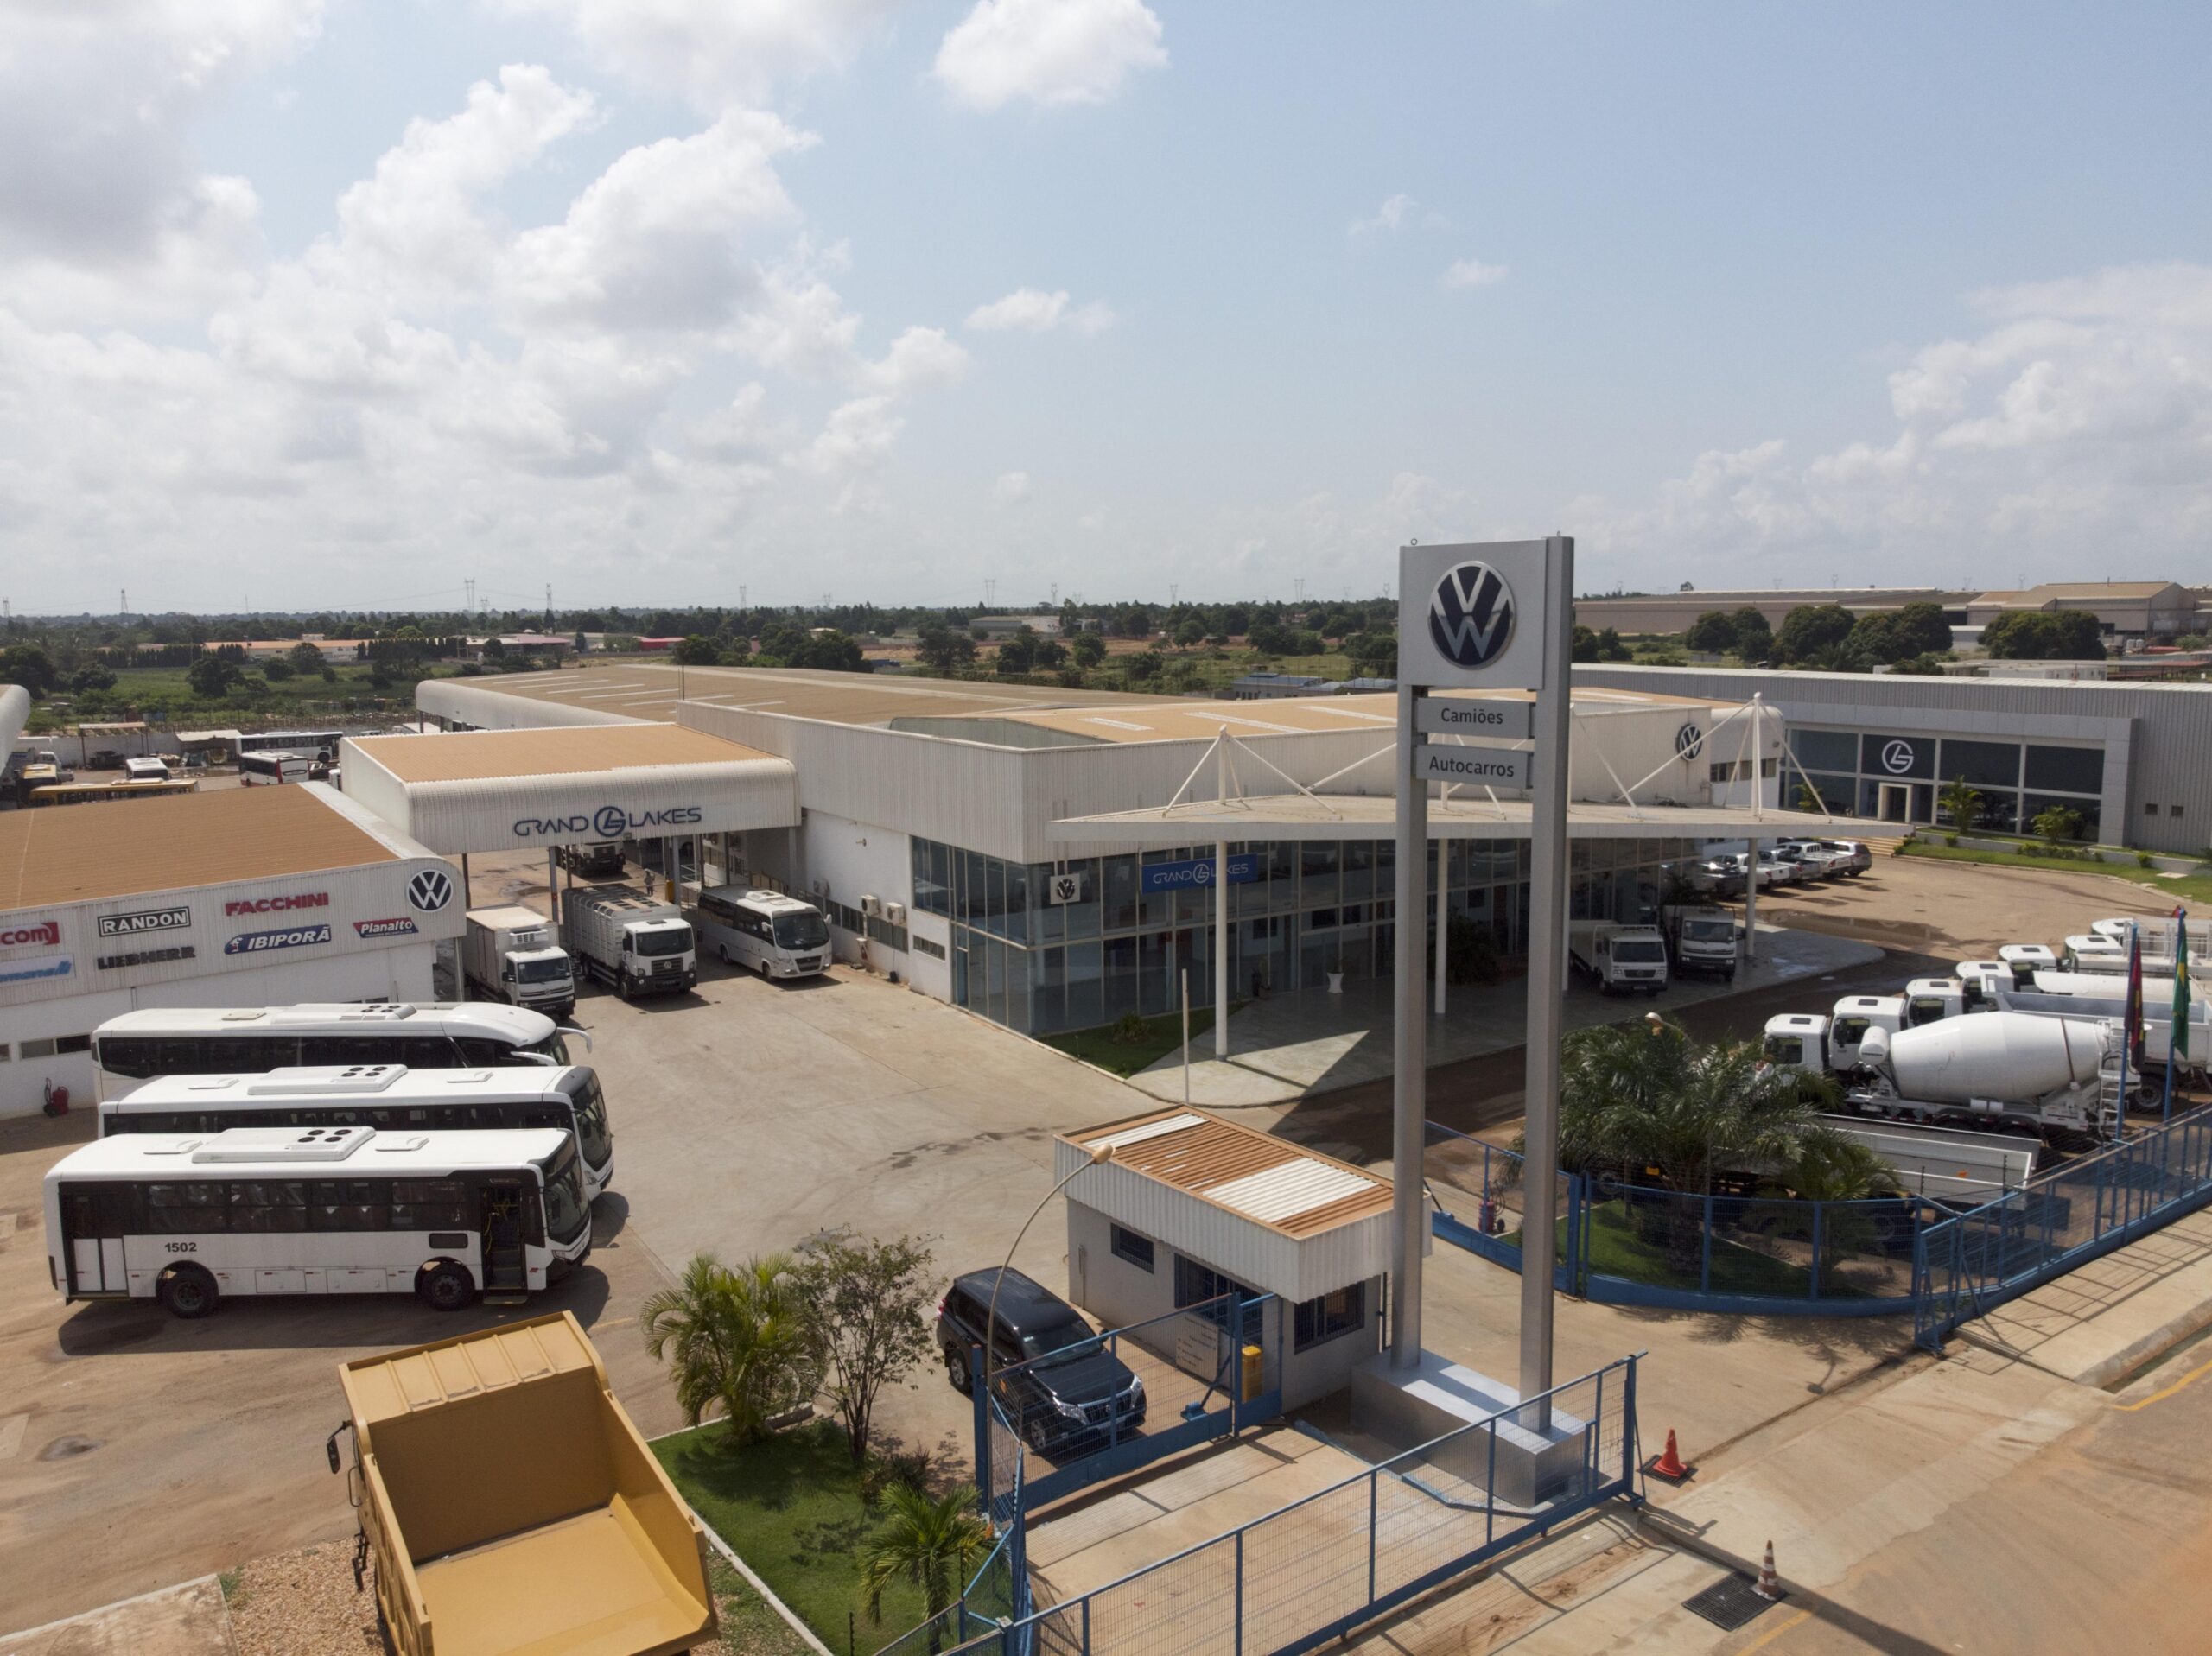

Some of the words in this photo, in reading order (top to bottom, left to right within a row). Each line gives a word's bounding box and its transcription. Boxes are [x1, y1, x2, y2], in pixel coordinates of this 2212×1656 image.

[1440, 707, 1504, 725] Camiões
[1429, 756, 1515, 777] Autocarros
[513, 815, 589, 836] GRAND
[629, 807, 702, 828] LAKES
[1153, 870, 1192, 884] GRAND
[1211, 863, 1249, 878] LKES
[226, 892, 329, 917] FACCHINI
[104, 911, 187, 933] RANDON
[361, 920, 413, 934] Planalto
[247, 926, 330, 950] IBIPORÃ
[97, 946, 196, 970] LIEBHERR
[165, 1242, 197, 1253] 1502
